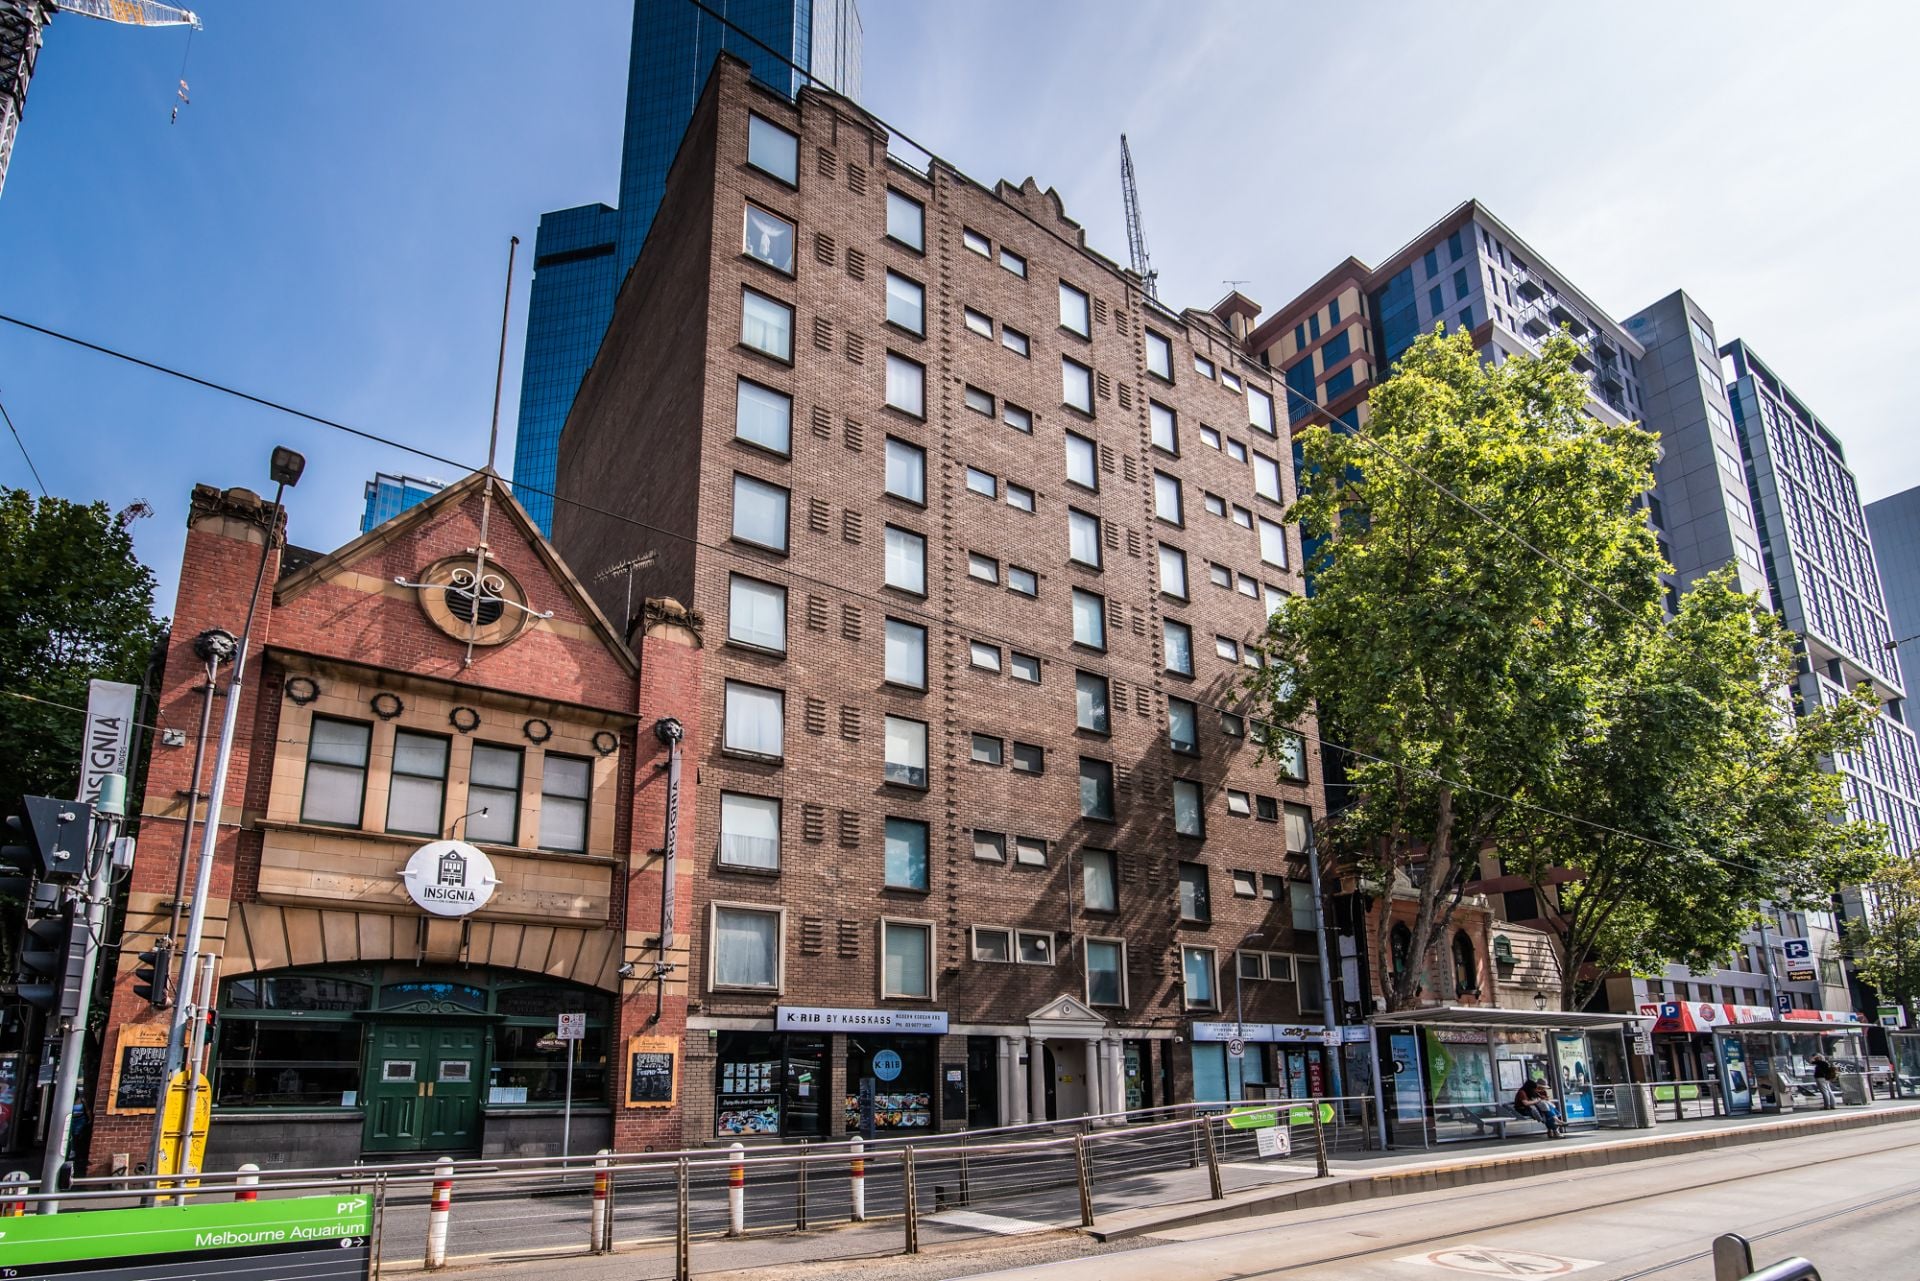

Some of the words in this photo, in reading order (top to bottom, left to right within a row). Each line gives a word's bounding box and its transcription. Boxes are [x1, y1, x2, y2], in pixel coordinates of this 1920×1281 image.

[423, 887, 476, 902] INSIGNIA
[1790, 943, 1803, 956] P
[1779, 997, 1787, 1007] P
[1665, 1006, 1675, 1016] P
[826, 1015, 838, 1023] BY
[842, 1015, 892, 1025] KASSKASS
[1230, 1043, 1242, 1051] 40
[195, 1228, 286, 1248] Melbourne
[289, 1222, 366, 1239] Aquarium
[3, 1268, 18, 1278] To
